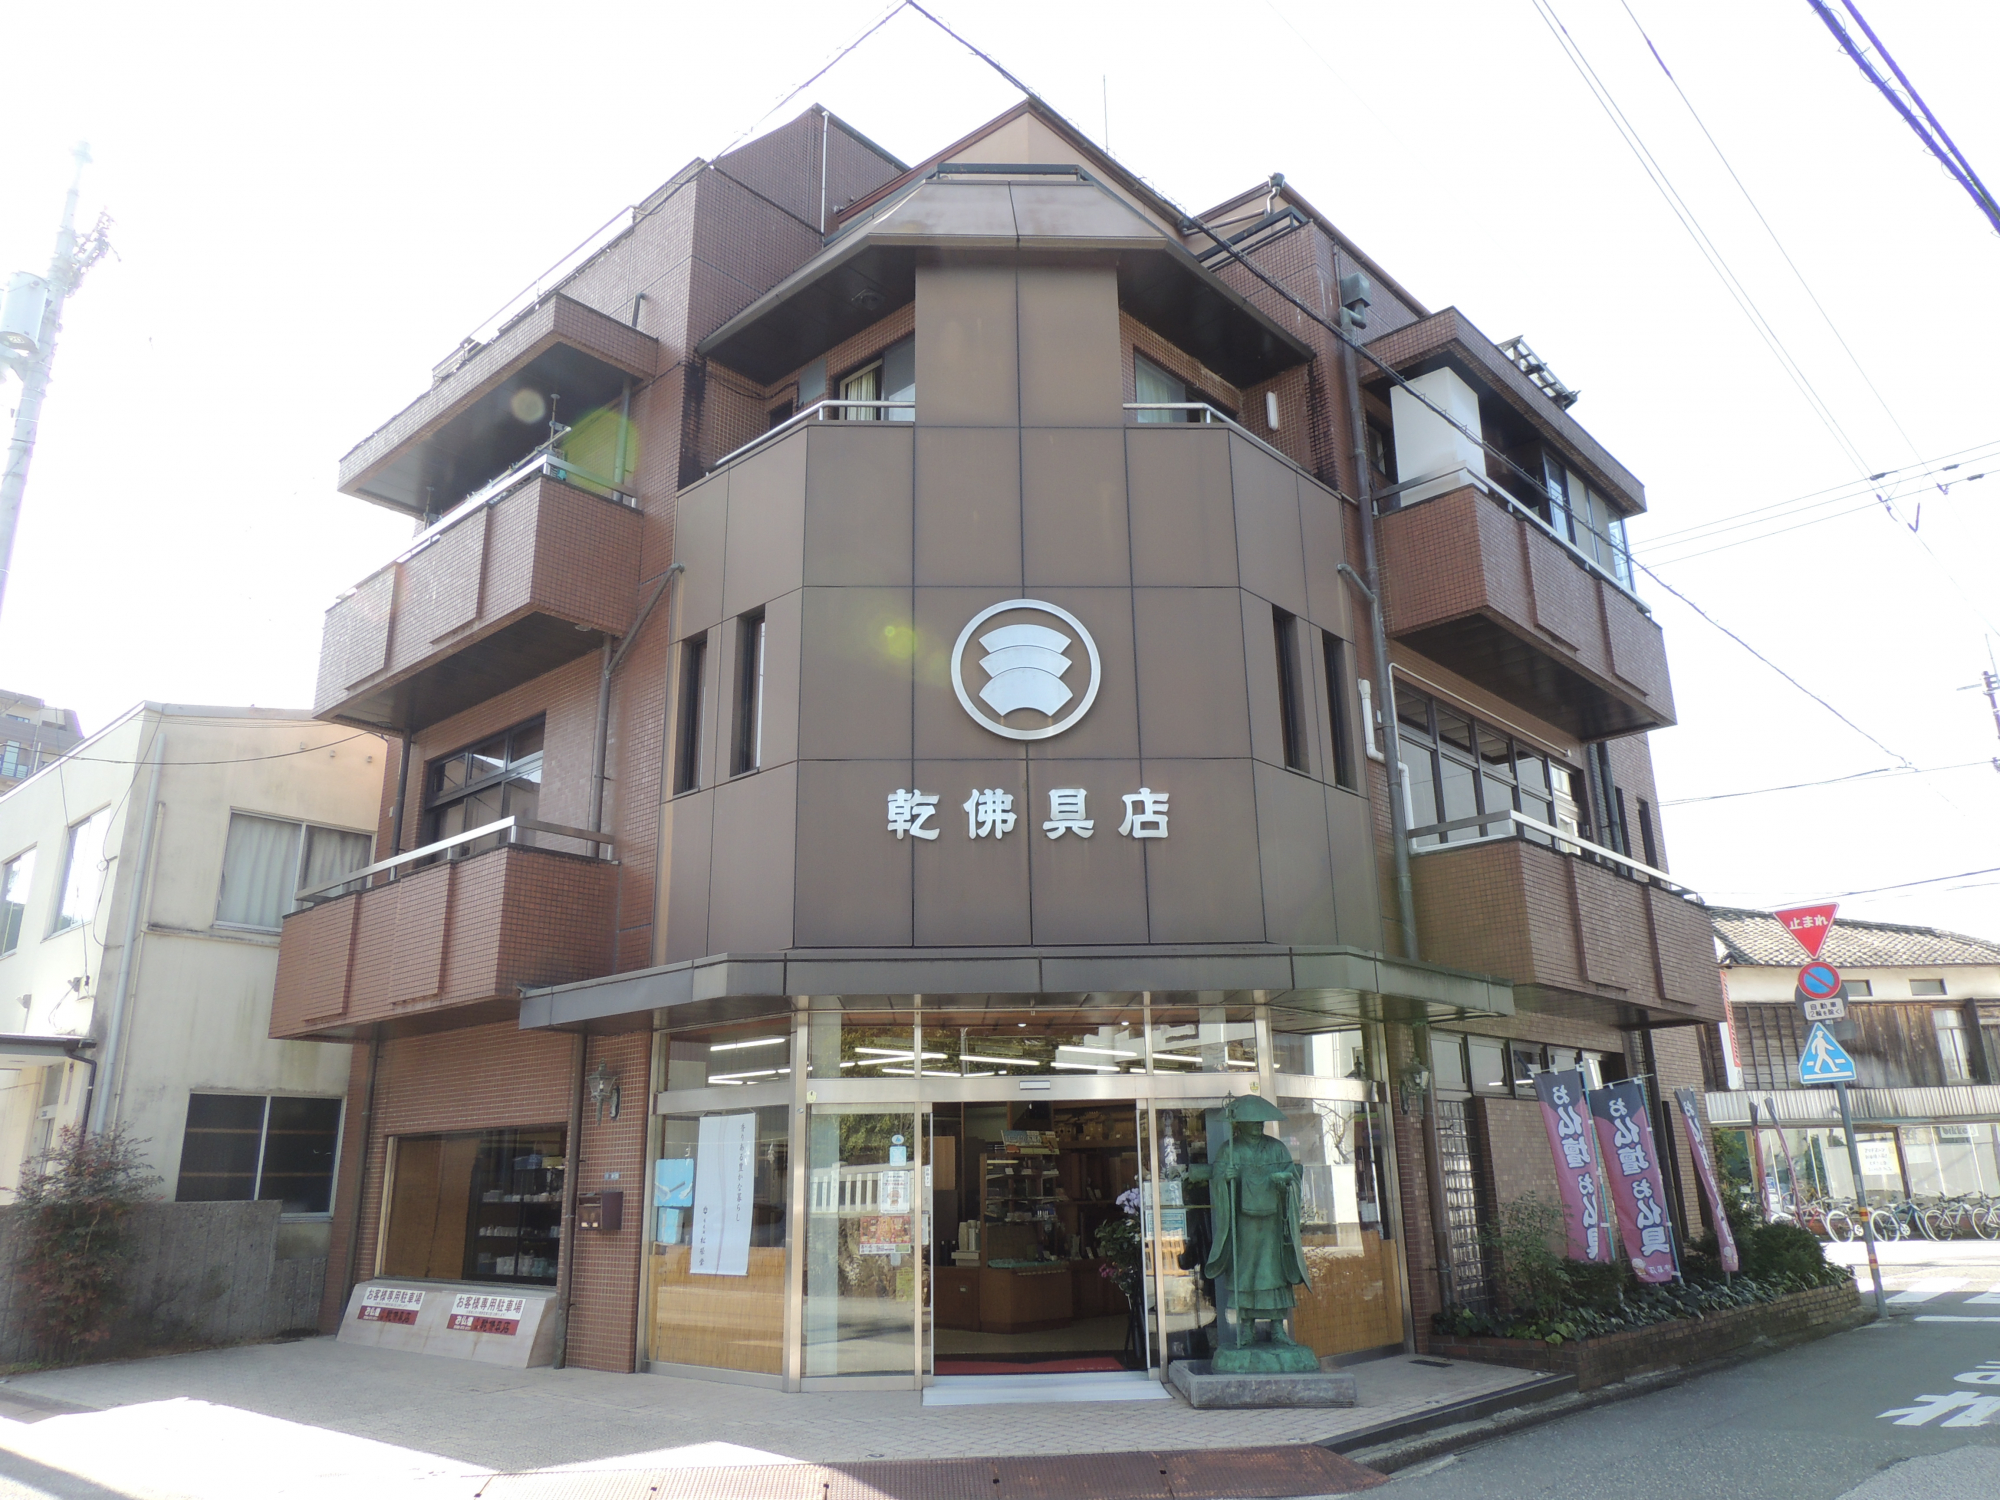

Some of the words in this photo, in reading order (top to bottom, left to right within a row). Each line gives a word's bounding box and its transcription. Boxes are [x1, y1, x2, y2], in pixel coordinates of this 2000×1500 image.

[887, 787, 1170, 840] 乾佛具店
[1789, 914, 1828, 931] 止まれ
[1810, 1002, 1837, 1010] 自動車
[366, 1289, 423, 1305] お客様専用駐車場
[456, 1296, 524, 1314] お客様専用駐車場
